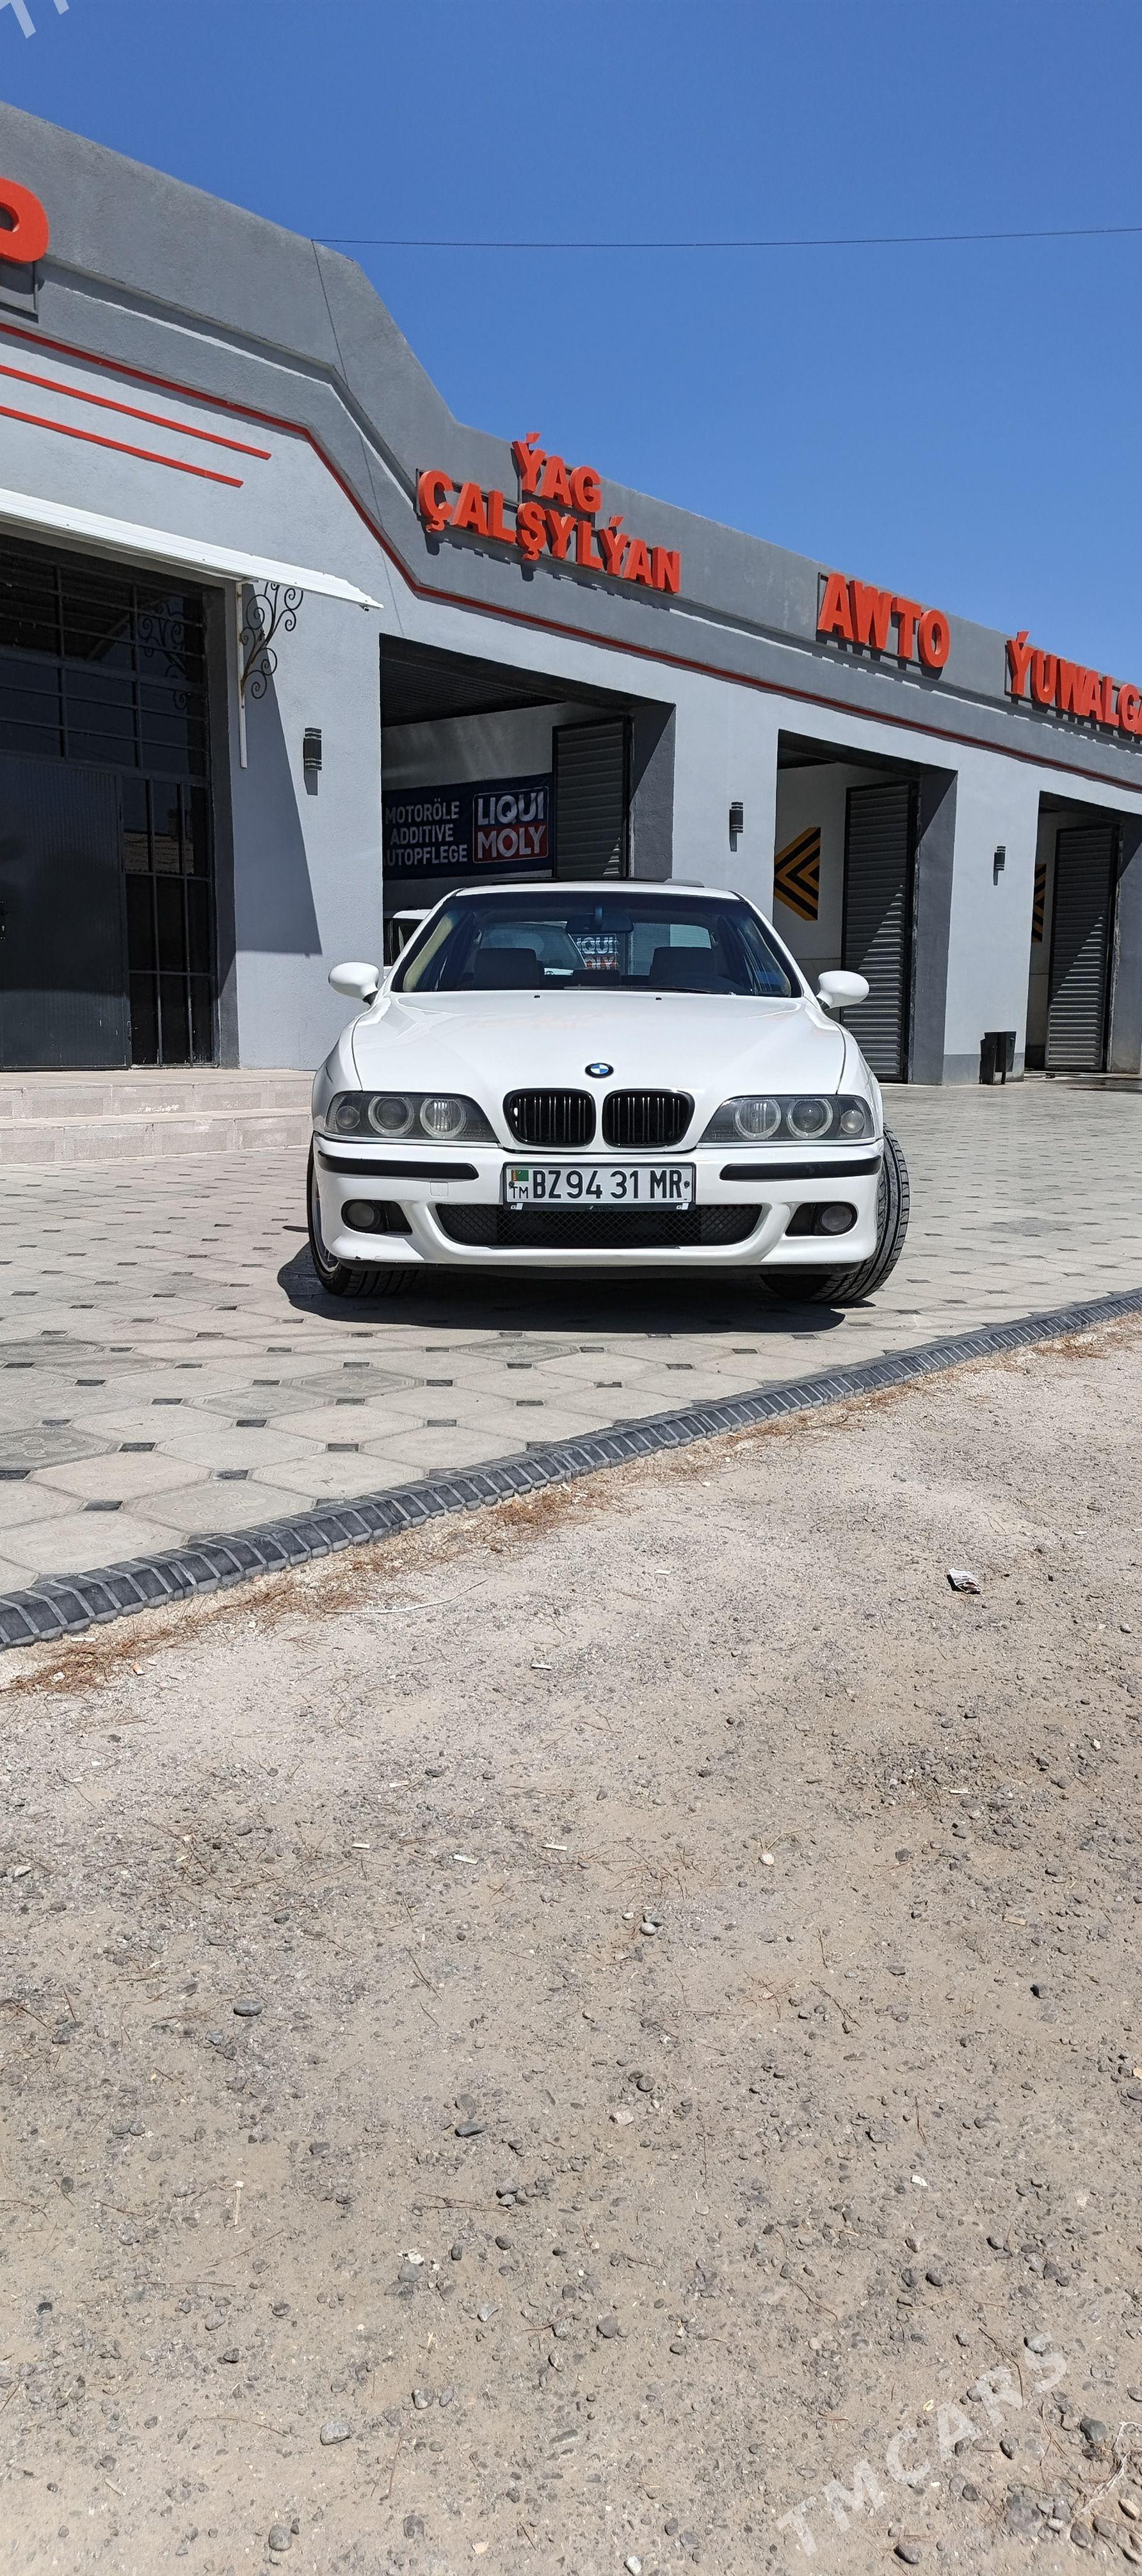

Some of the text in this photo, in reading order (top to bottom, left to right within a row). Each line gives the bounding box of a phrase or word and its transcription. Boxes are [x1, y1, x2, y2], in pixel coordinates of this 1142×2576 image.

[513, 432, 601, 513] ÝAG
[419, 470, 680, 593] ÇALŞYLÝAN
[817, 573, 950, 668] AWTO
[1007, 631, 1142, 734] ÝUWALG
[385, 798, 460, 825] MOTORÖLE
[478, 791, 544, 825] LIQUI
[390, 824, 454, 845] ADDITIVE
[477, 825, 546, 858] MOLY
[512, 1186, 529, 1199] TM
